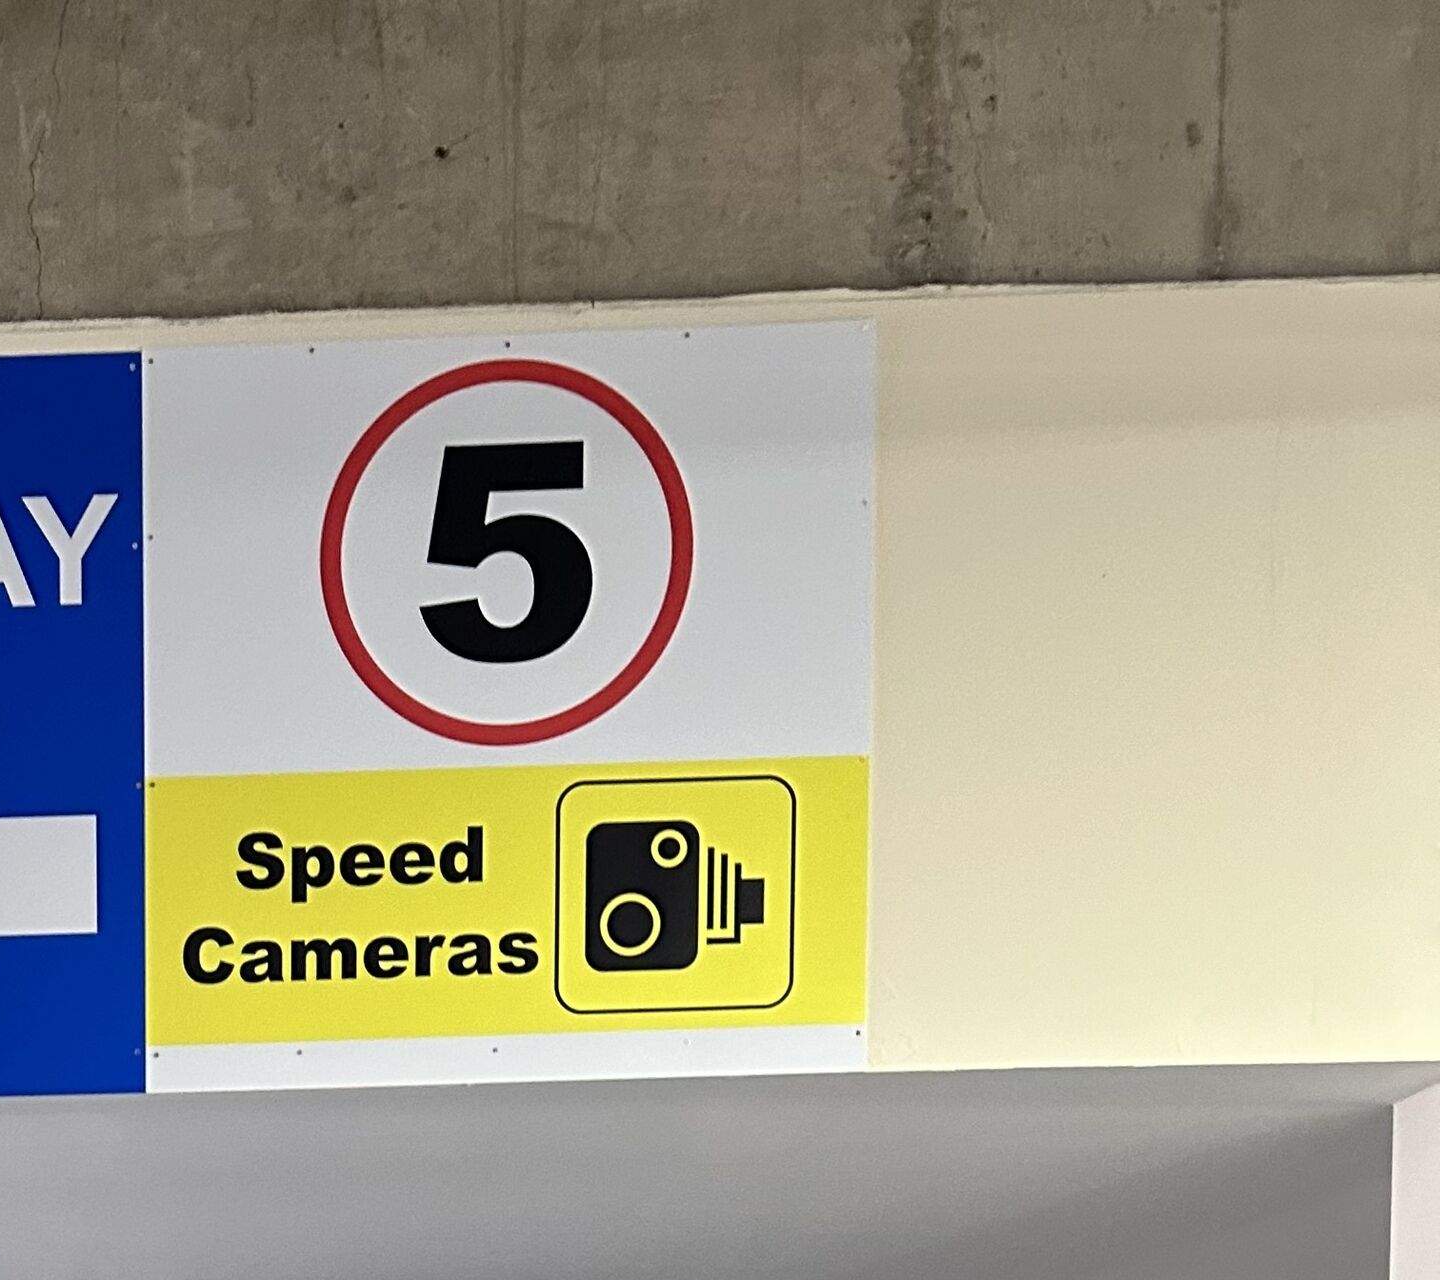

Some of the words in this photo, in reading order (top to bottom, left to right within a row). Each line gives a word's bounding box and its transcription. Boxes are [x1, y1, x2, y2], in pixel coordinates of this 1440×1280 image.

[418, 440, 594, 664] 5
[235, 825, 485, 903] Speed
[181, 926, 540, 985] Cameras
